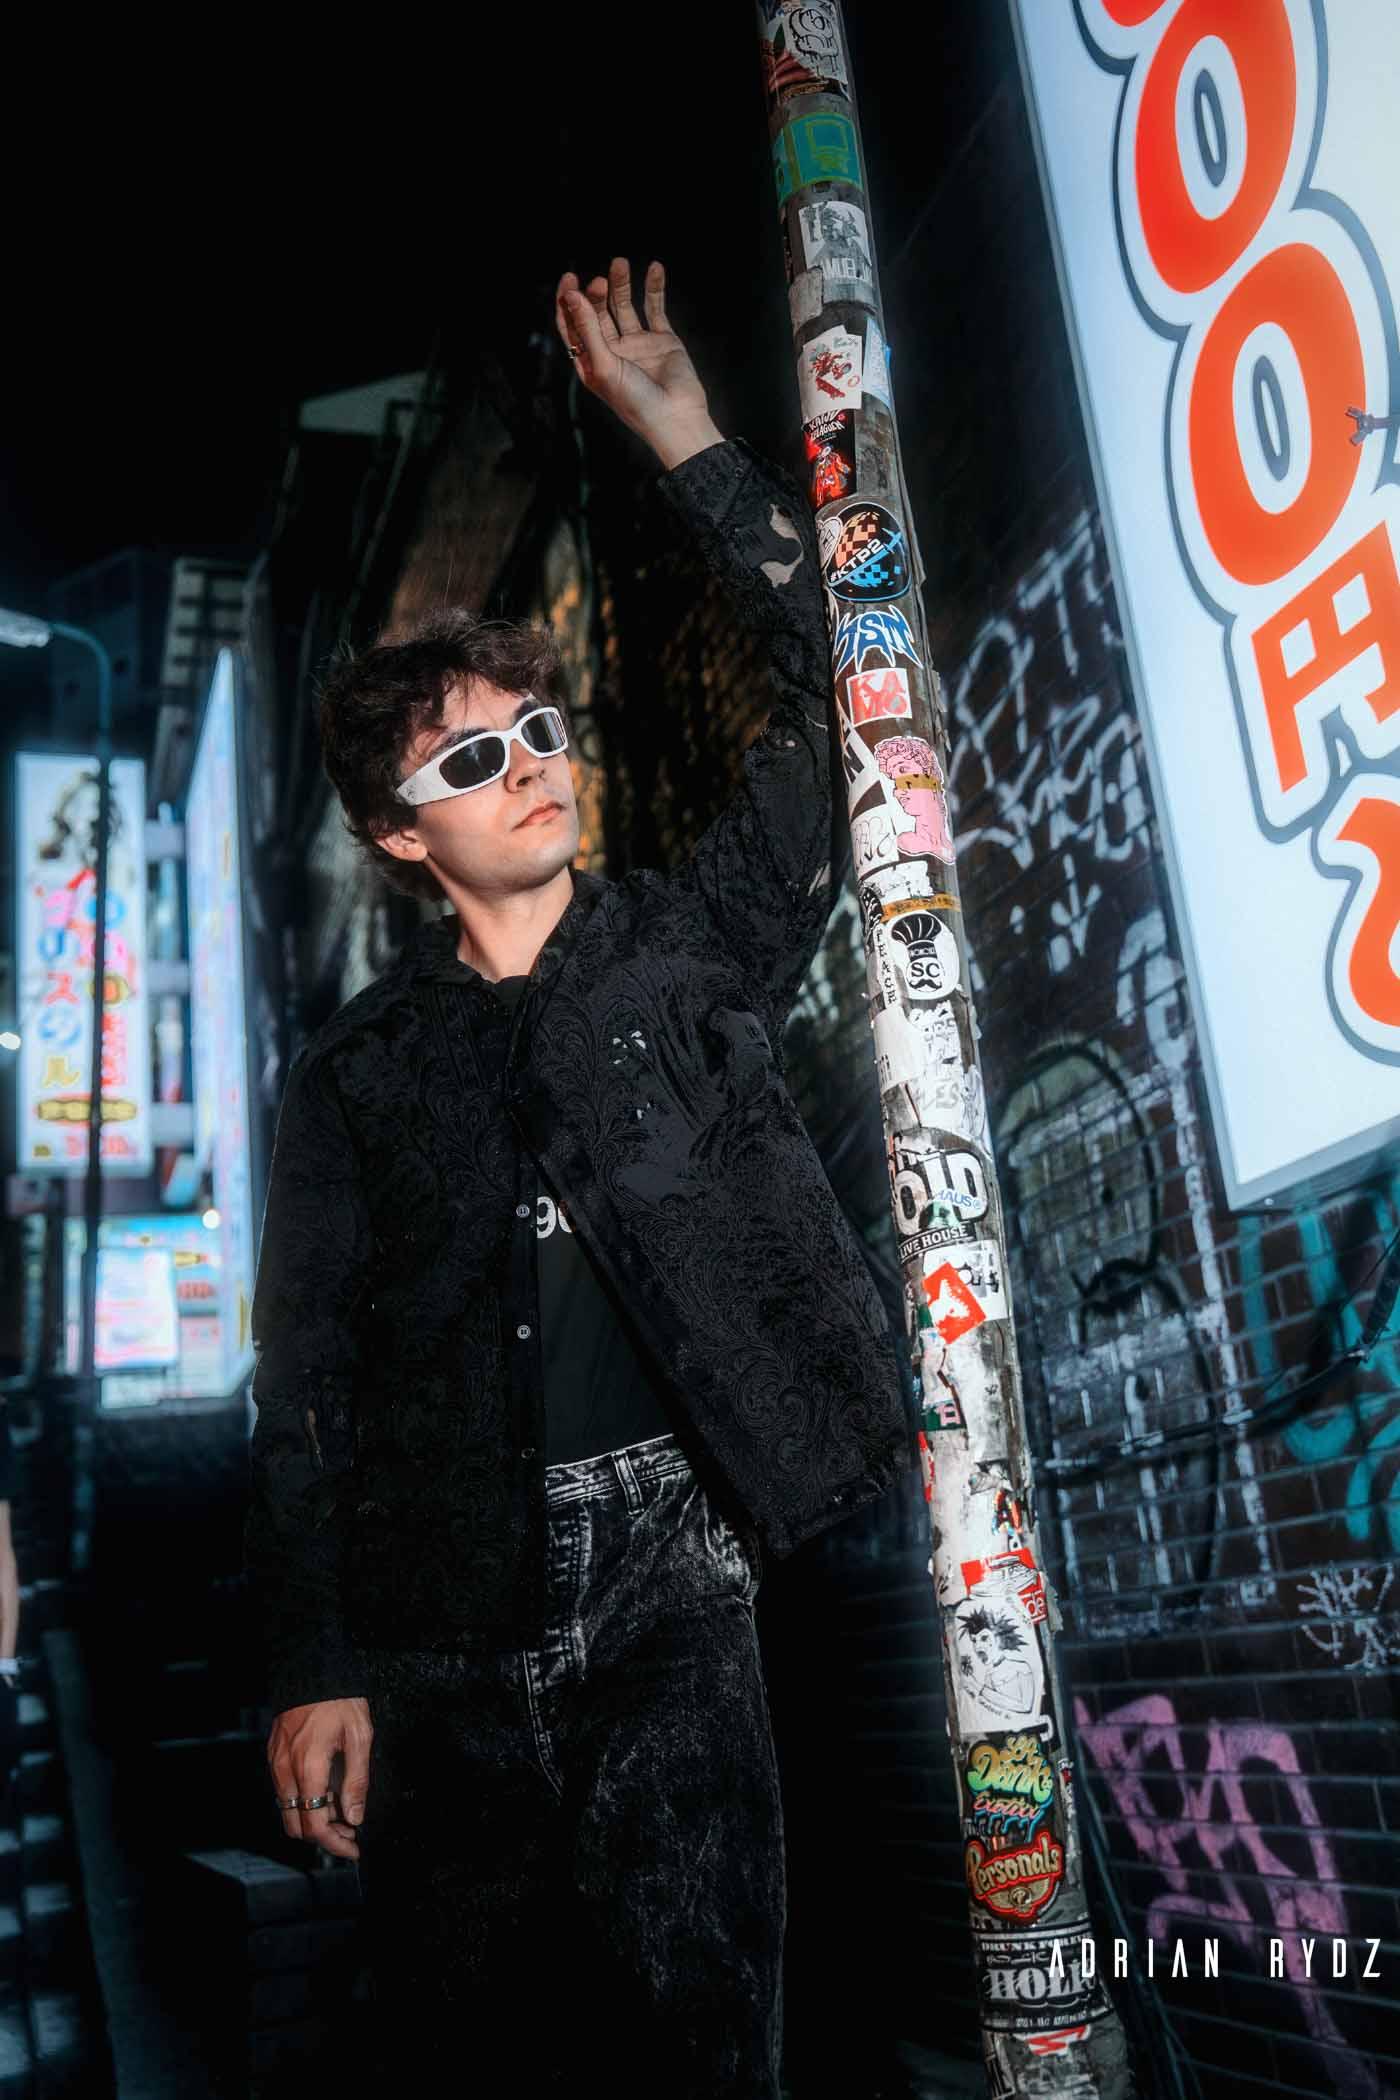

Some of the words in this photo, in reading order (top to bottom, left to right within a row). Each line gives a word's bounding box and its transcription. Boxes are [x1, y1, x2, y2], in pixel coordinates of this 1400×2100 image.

[910, 962, 941, 978] SC
[922, 1225, 969, 1248] HOUSE
[966, 1835, 1062, 1896] Personals
